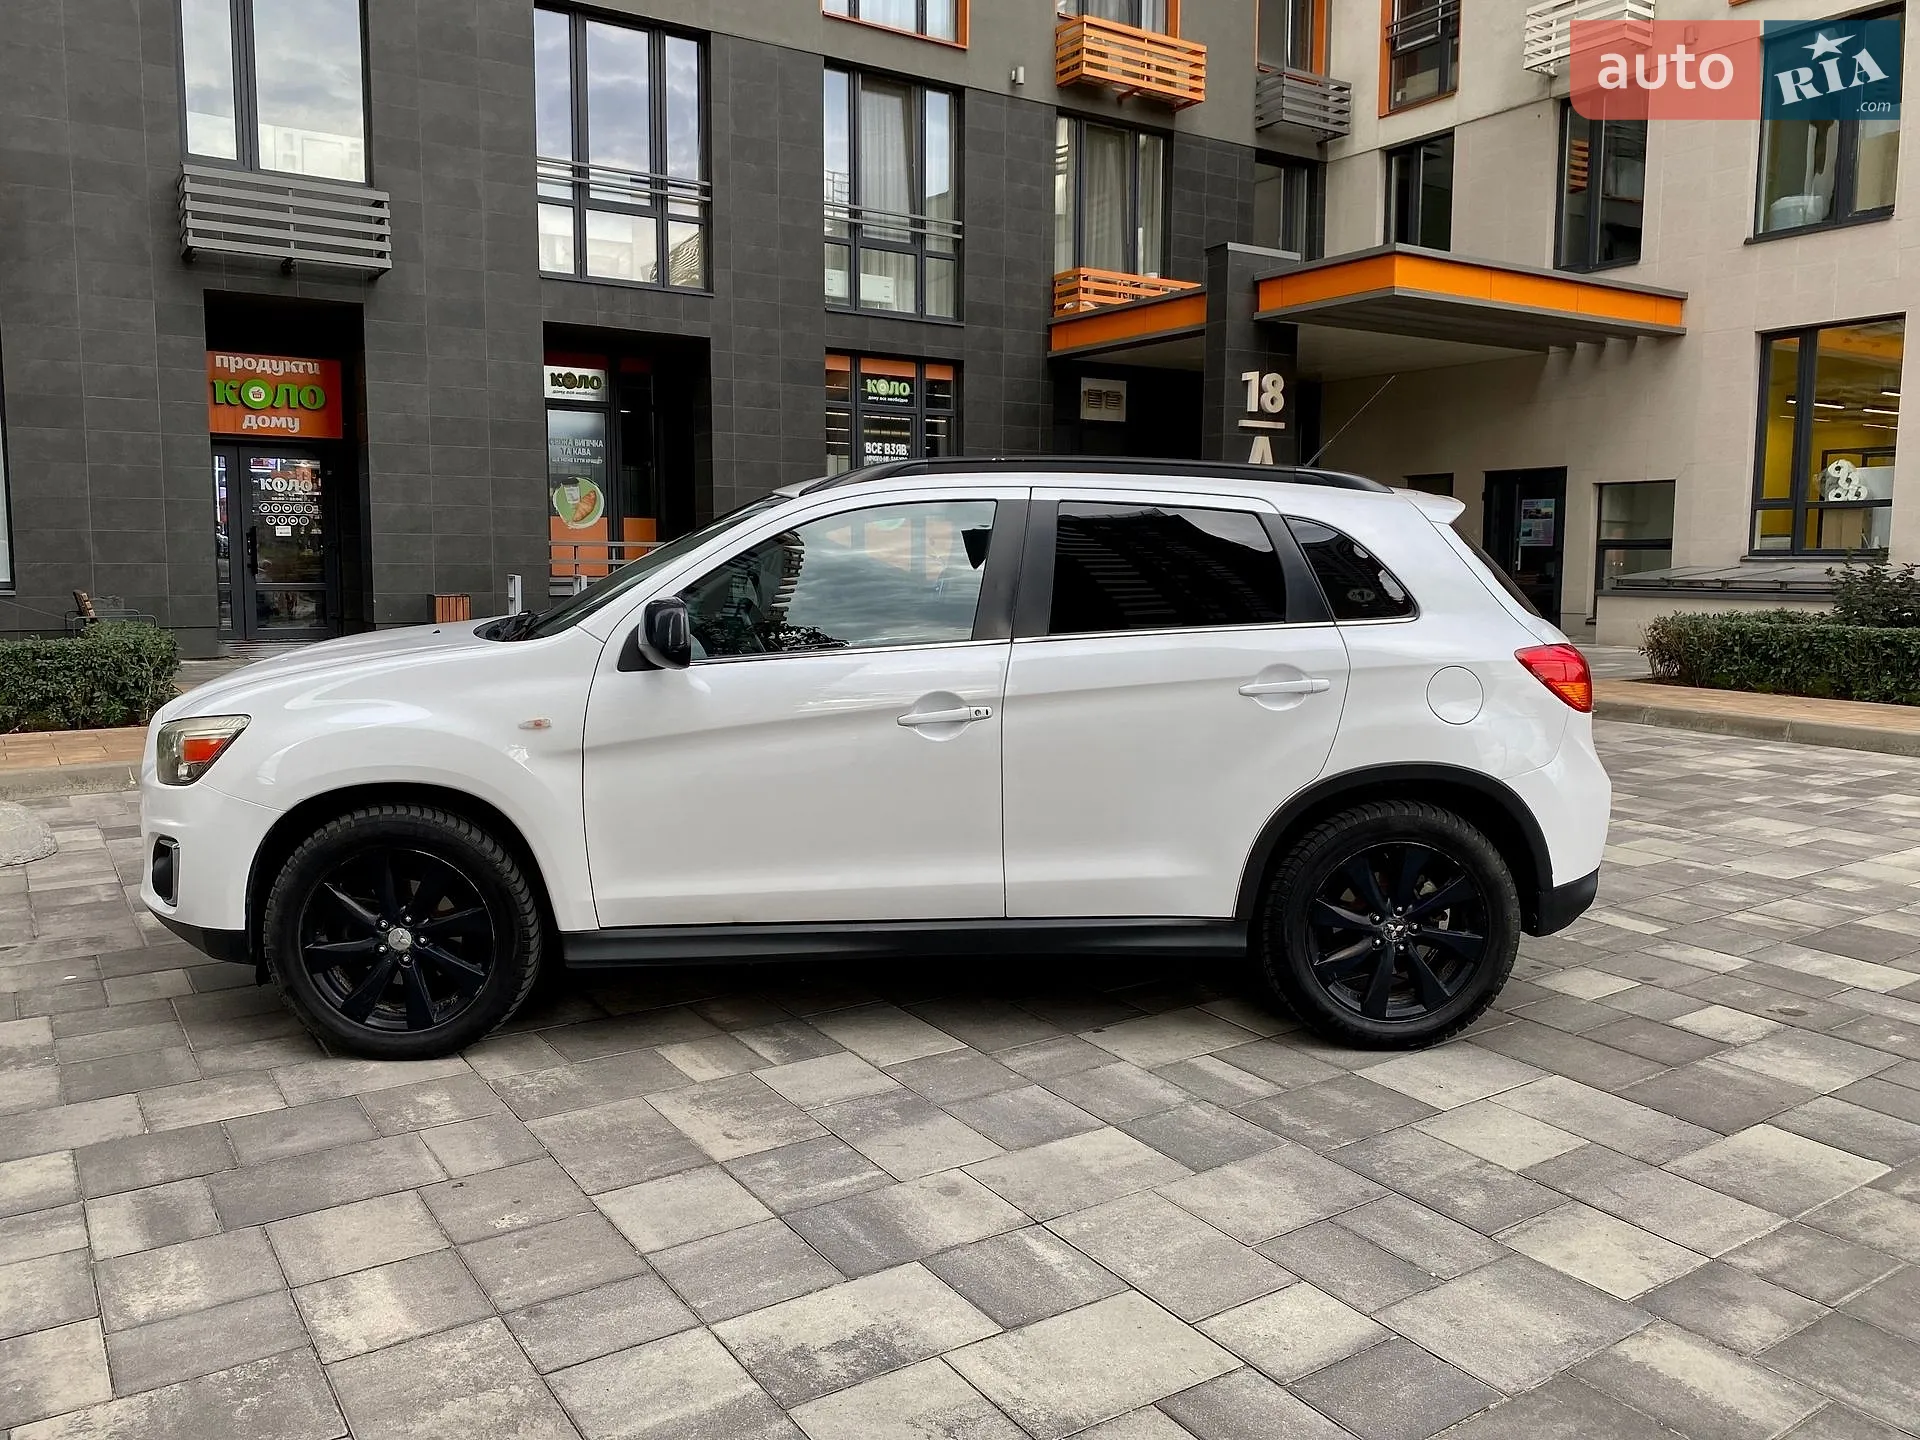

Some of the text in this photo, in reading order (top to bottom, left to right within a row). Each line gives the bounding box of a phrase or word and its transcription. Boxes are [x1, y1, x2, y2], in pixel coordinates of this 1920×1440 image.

[215, 355, 320, 376] продукти
[1241, 371, 1285, 413] 18
[242, 414, 300, 433] дому
[572, 447, 592, 456] КАВА
[865, 442, 883, 454] ВСЕ
